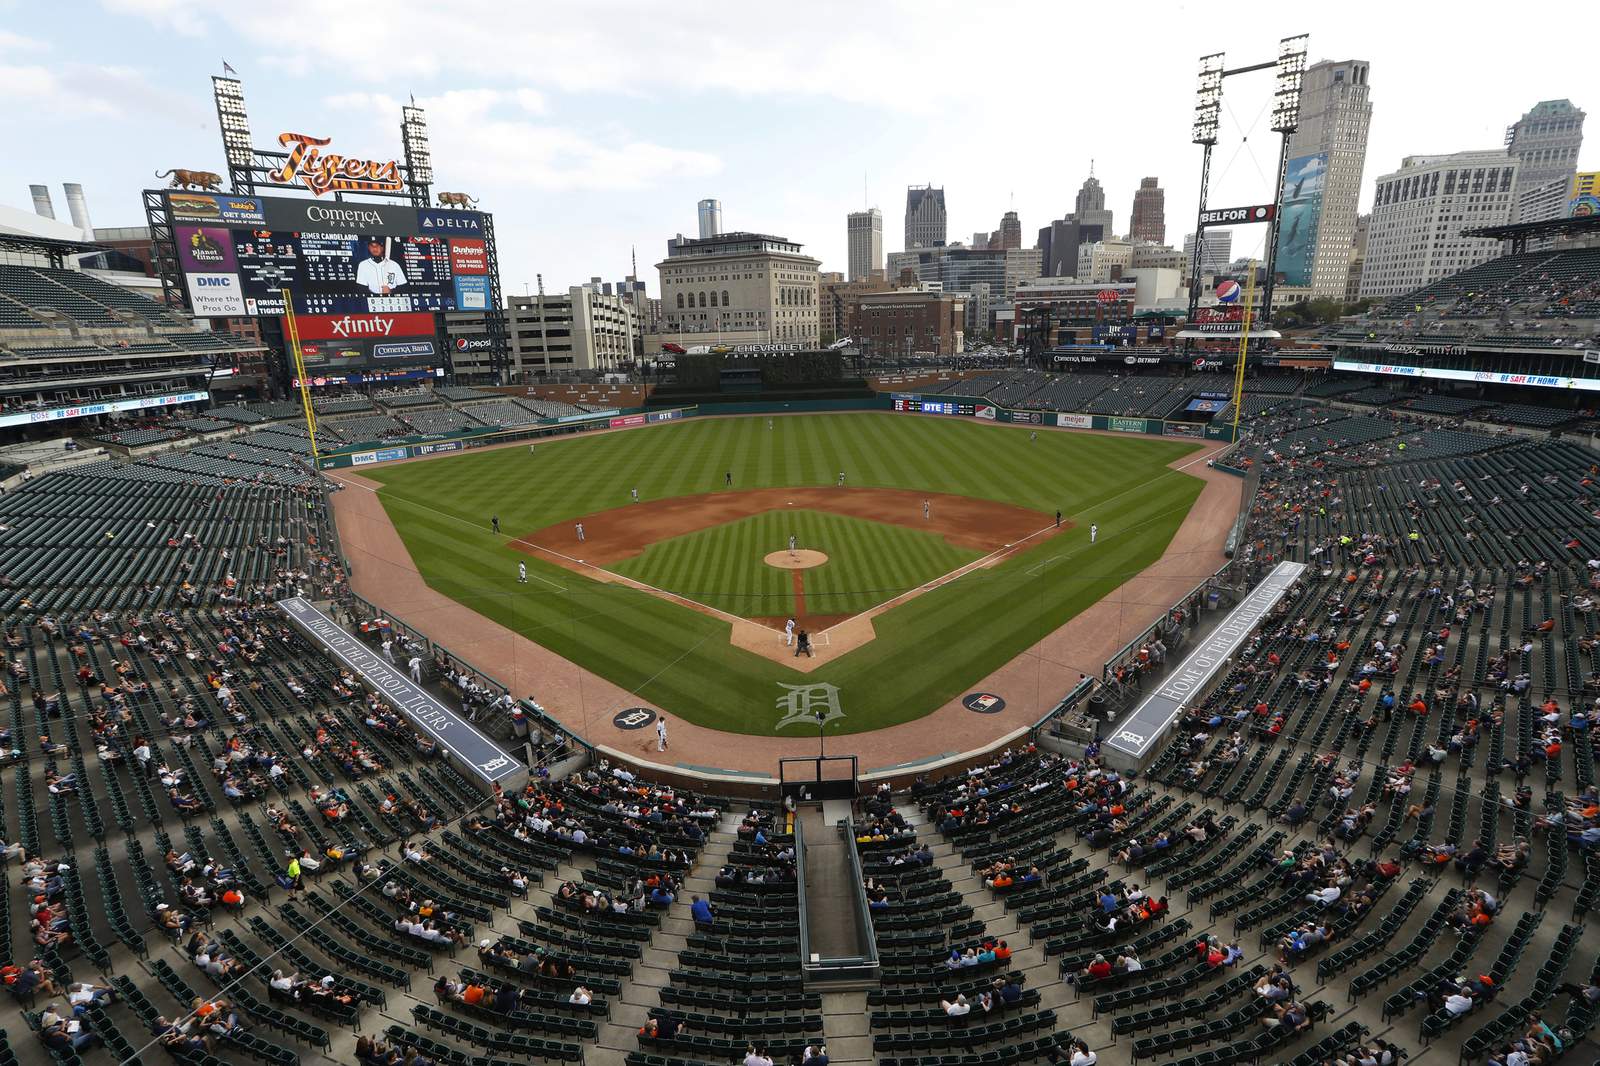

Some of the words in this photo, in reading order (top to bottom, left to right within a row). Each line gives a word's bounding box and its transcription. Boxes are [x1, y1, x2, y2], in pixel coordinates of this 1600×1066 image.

[269, 132, 404, 198] Tigers
[241, 212, 263, 220] SOME
[1201, 209, 1247, 223] BELFOR
[330, 221, 366, 229] PARK
[436, 217, 479, 229] DELTA
[300, 232, 321, 240] JEIMER
[321, 233, 359, 241] CANDELARIO
[192, 248, 218, 256] planet
[452, 246, 484, 254] Dunham's
[196, 278, 231, 287] DMC
[202, 304, 222, 312] Pros
[224, 304, 237, 312] Go
[332, 316, 393, 337] xfinity
[1109, 325, 1121, 333] Lite
[469, 339, 491, 348] pepsi
[737, 343, 803, 352] CHEVROLET
[1400, 367, 1415, 375] HOME
[1509, 375, 1526, 384] SAFE
[1526, 376, 1536, 384] AT
[1536, 377, 1559, 386] HOME
[159, 397, 166, 405] BE
[166, 395, 177, 404] SAFE
[184, 394, 196, 402] HOME
[56, 410, 65, 418] BE
[65, 407, 81, 417] SAFE
[81, 405, 88, 415] AT
[88, 405, 105, 414] HOME
[924, 403, 942, 412] DTE
[1064, 415, 1087, 424] meijer
[1113, 418, 1143, 427] EASTERN
[354, 454, 376, 464] DMC
[1162, 669, 1204, 700] HOME
[1195, 651, 1217, 668] OF
[1206, 634, 1235, 659] THE
[1222, 597, 1261, 638] DETROIT
[309, 618, 337, 639] HOME
[342, 644, 366, 665] THE
[359, 654, 411, 698] DETROIT
[407, 693, 454, 732] TIGERS
